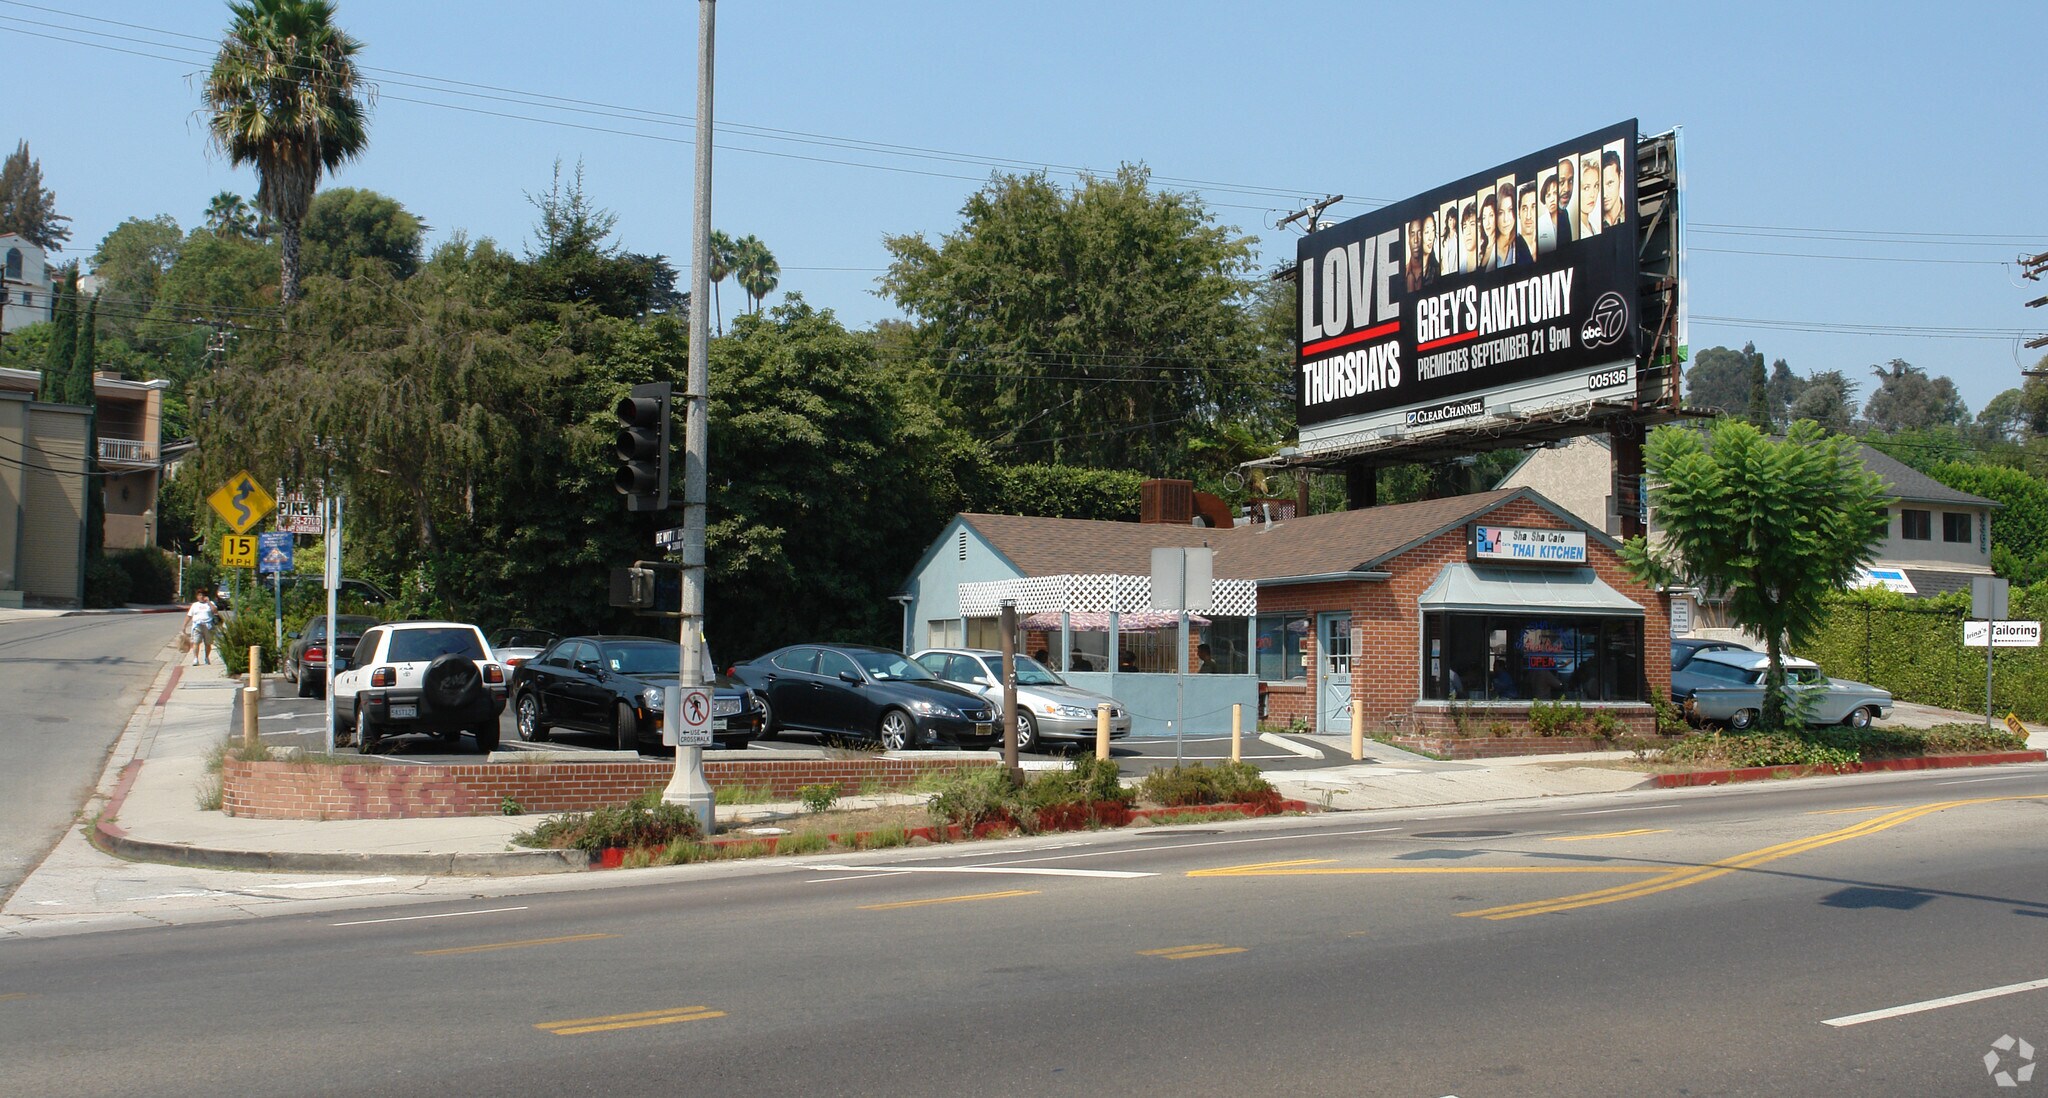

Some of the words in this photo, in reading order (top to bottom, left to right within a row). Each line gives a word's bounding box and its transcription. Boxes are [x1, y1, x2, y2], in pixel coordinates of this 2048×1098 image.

[1303, 228, 1400, 343] LOVE
[1417, 285, 1478, 344] GREY'S
[1479, 268, 1574, 336] ANATOMY
[1582, 326, 1601, 340] abc
[1418, 353, 1469, 382] PREMIERES
[1471, 338, 1529, 371] SEPTEMBER
[1532, 330, 1545, 356] 21
[1549, 325, 1571, 353] 9PM
[1303, 340, 1401, 407] THURSDAYS
[1589, 369, 1627, 390] 005136
[656, 532, 663, 545] DE
[1512, 530, 1527, 541] Sha
[1531, 531, 1545, 542] Sha
[1548, 533, 1565, 543] Cafe
[229, 538, 251, 556] 15
[1512, 544, 1535, 558] THAI
[1539, 546, 1584, 559] KITCHEN
[226, 558, 251, 566] MPH
[1966, 627, 1987, 640] Irina's
[1991, 624, 2038, 638] Tailoring
[1530, 656, 1556, 668] OPEN
